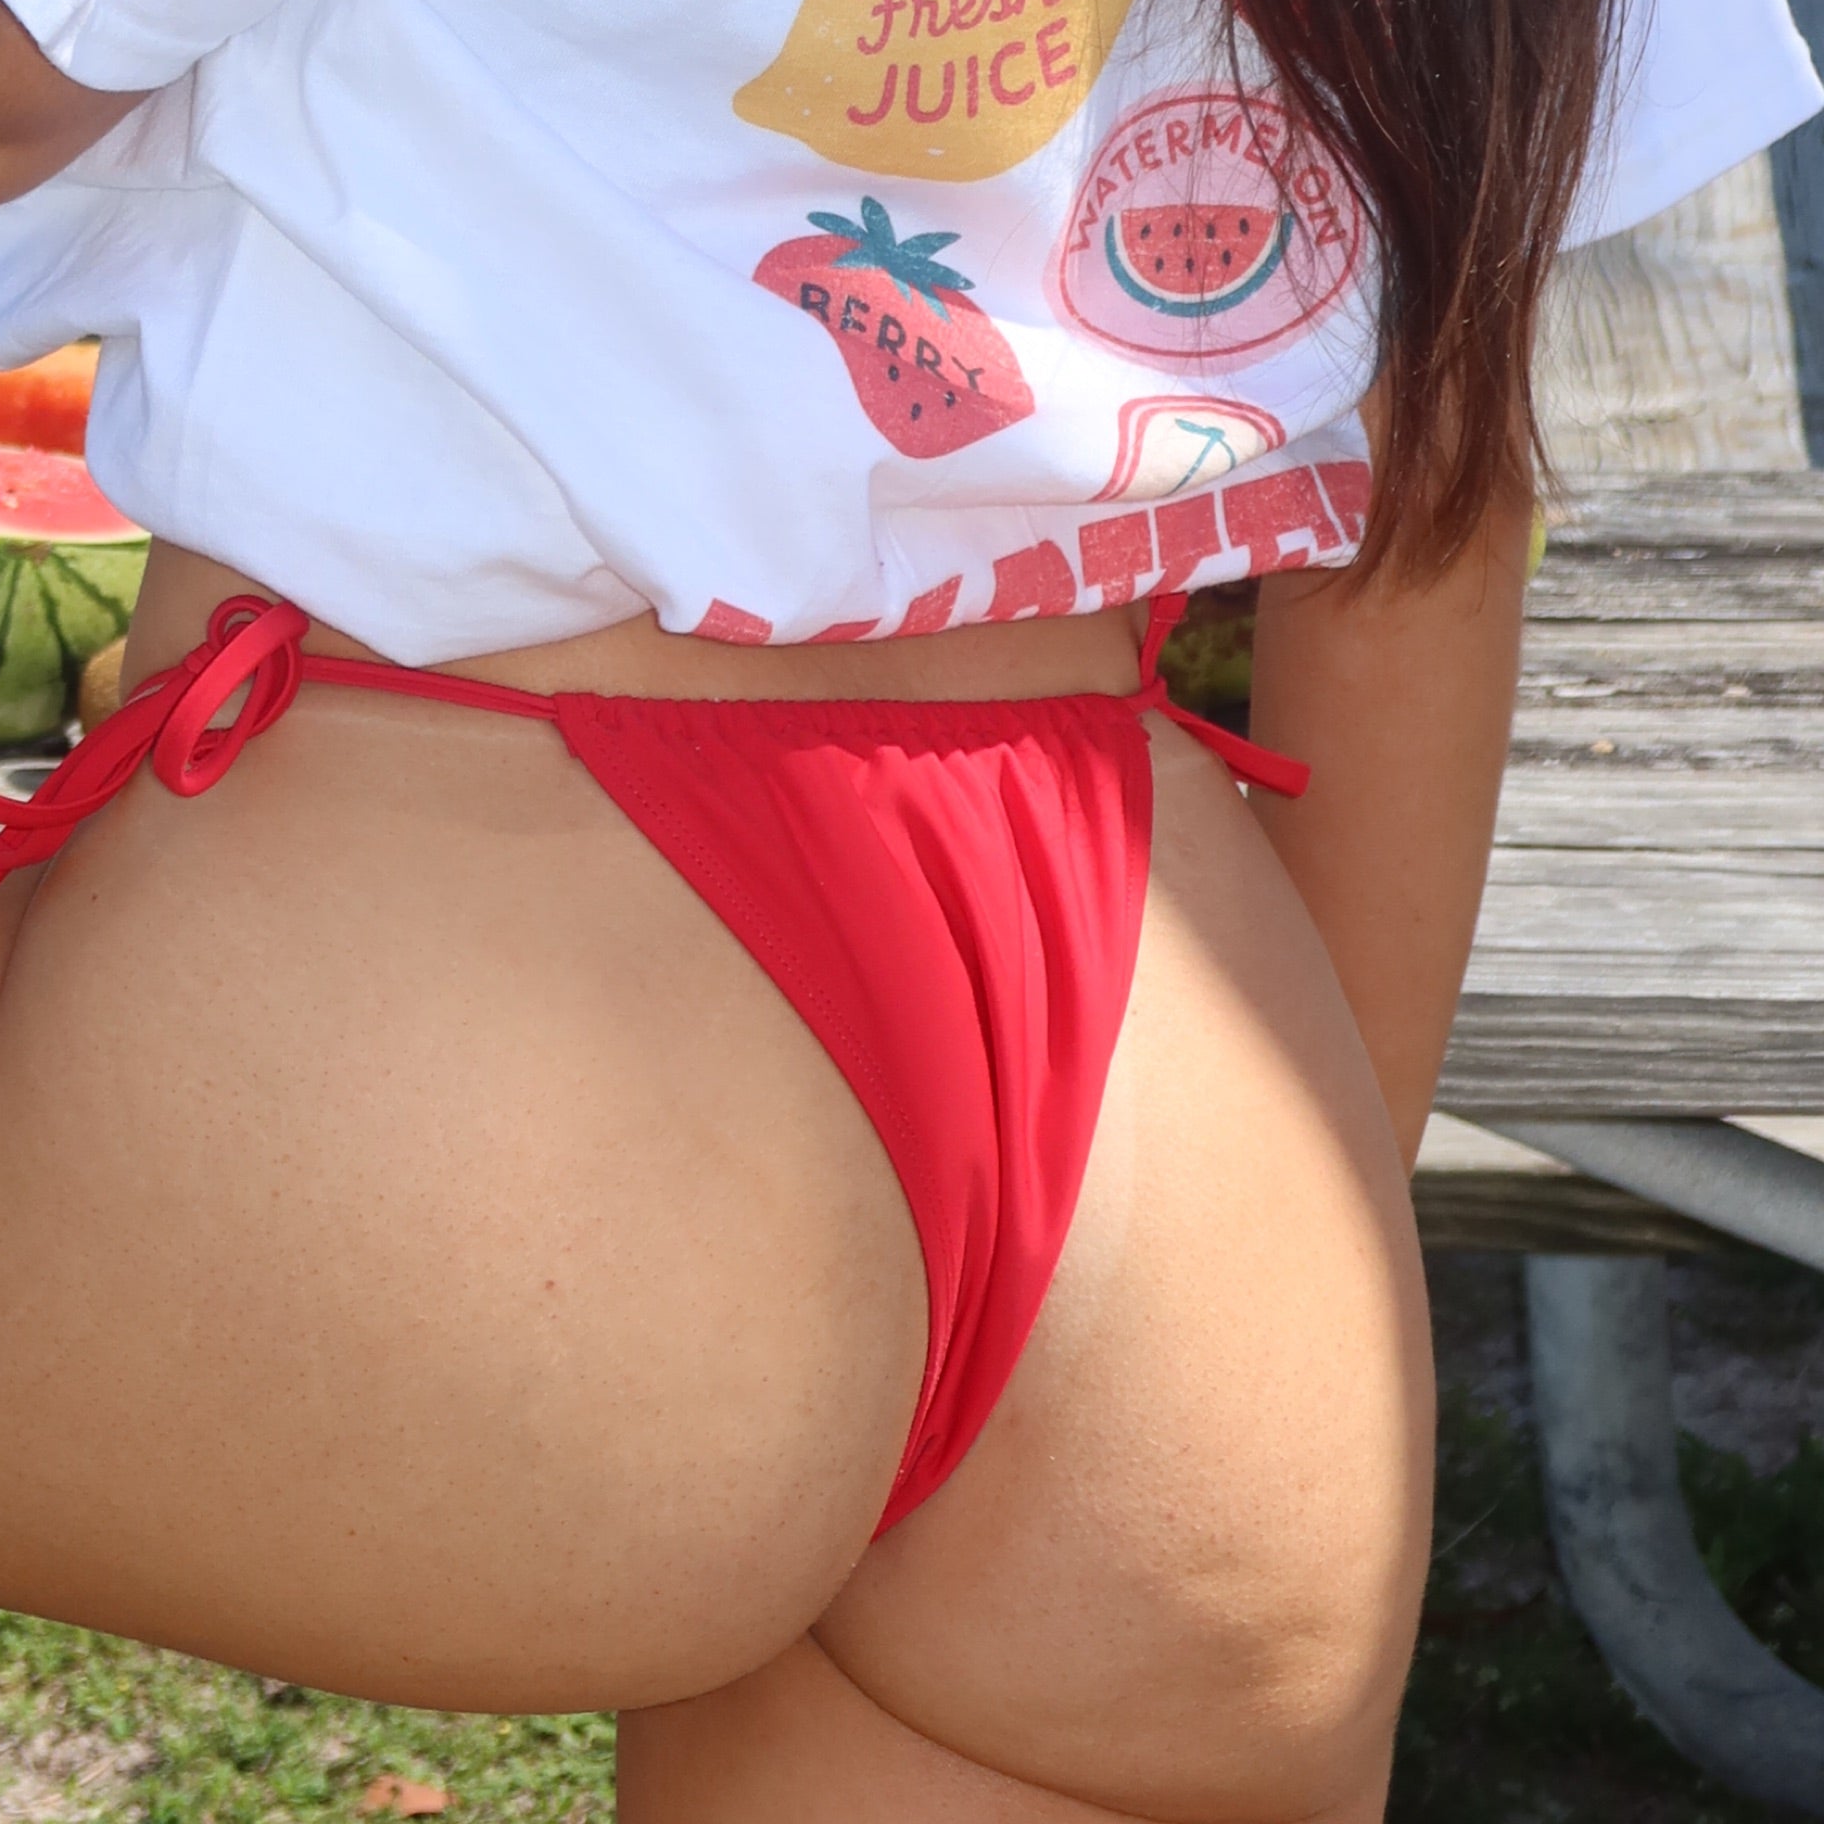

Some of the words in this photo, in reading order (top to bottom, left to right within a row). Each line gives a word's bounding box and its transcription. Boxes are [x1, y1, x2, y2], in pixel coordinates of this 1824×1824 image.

[846, 17, 1078, 126] JUICE
[1069, 113, 1347, 254] WATERMELON
[800, 282, 985, 392] BERRY
